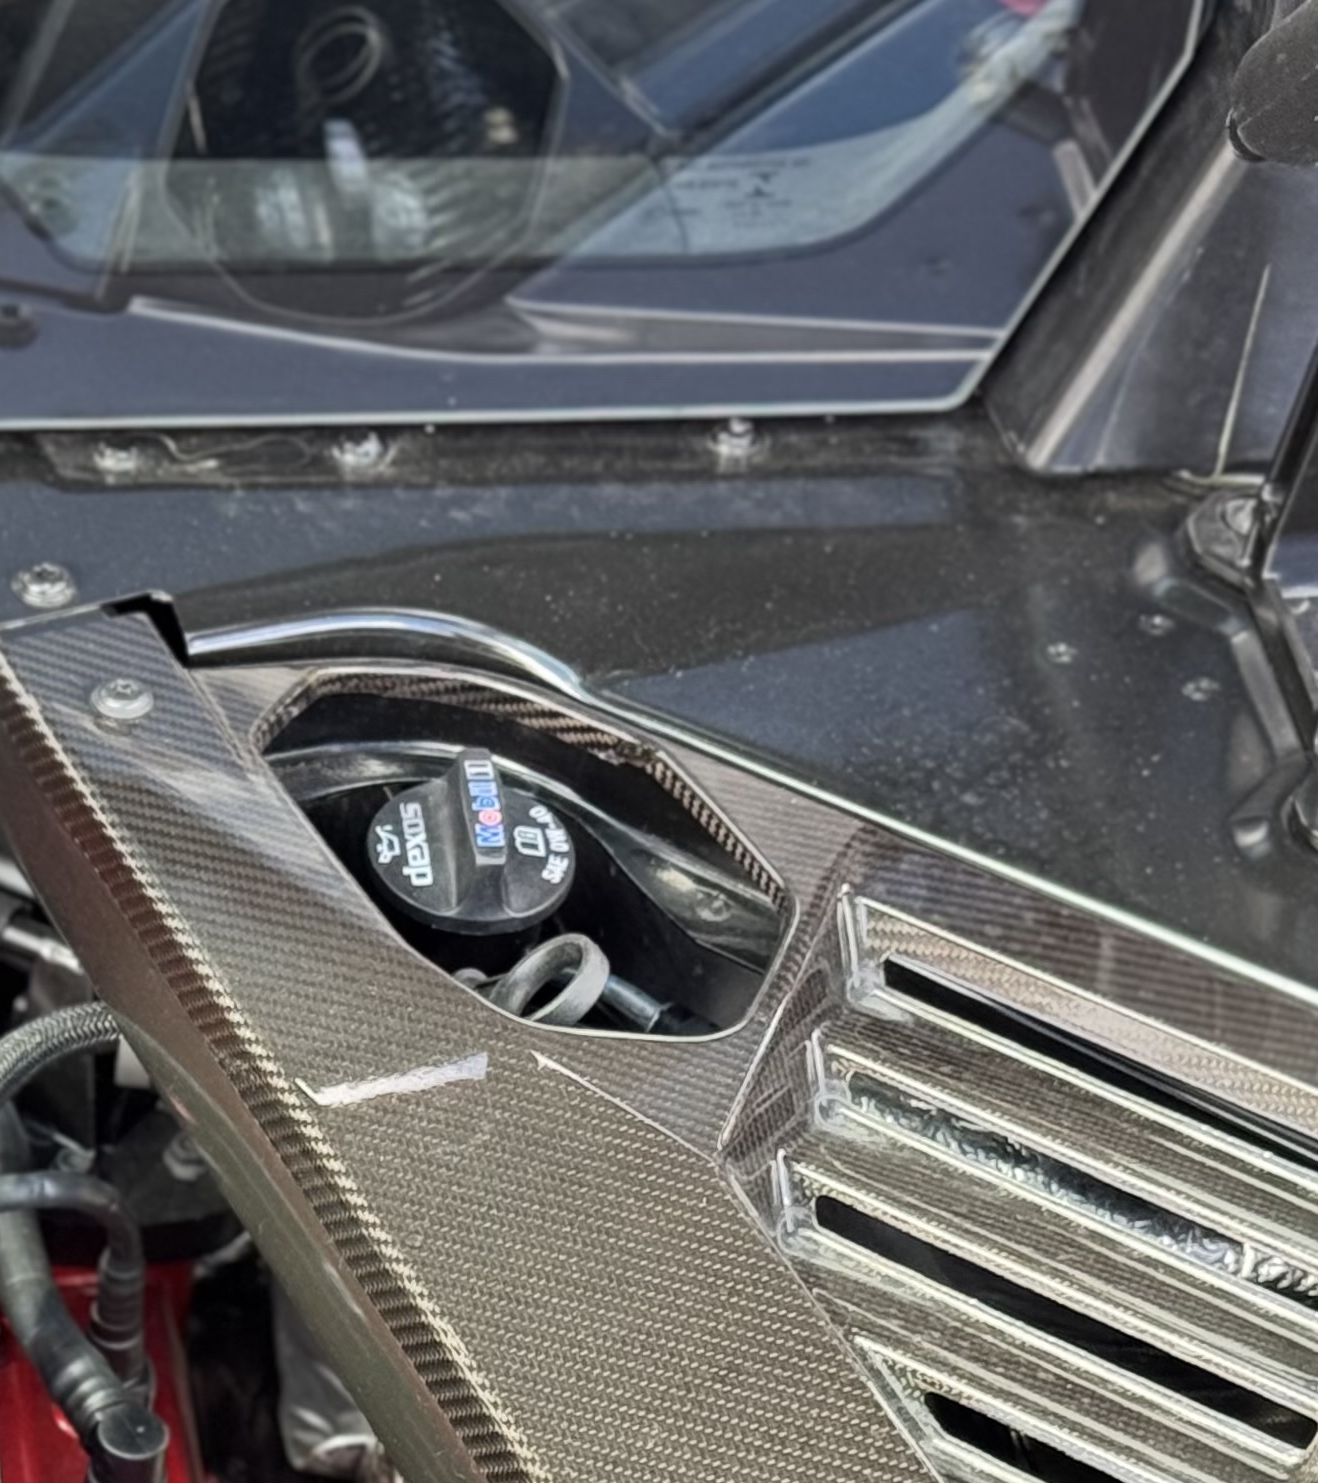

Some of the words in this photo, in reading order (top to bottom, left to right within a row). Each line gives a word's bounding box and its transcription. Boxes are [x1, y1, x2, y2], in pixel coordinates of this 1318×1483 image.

[468, 780, 506, 847] Mobil
[528, 804, 570, 853] 0W-40
[399, 802, 434, 887] dexos
[541, 853, 570, 884] SAE
